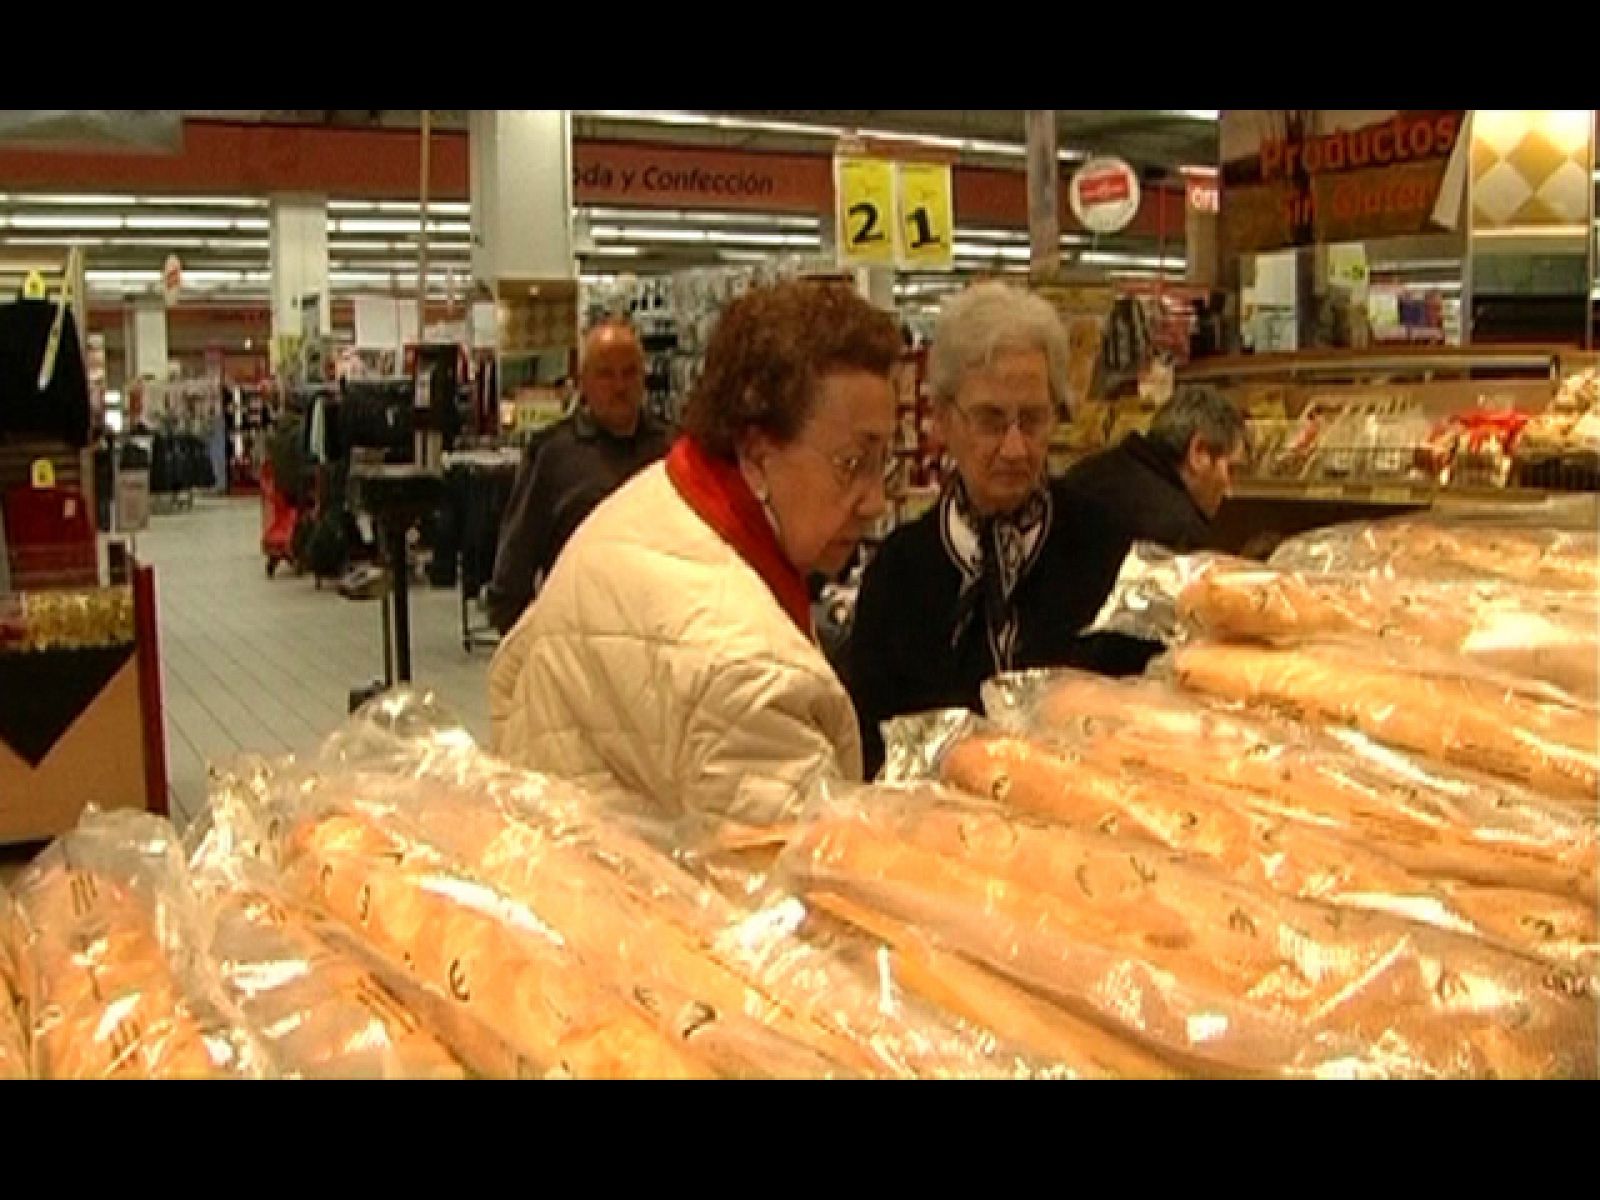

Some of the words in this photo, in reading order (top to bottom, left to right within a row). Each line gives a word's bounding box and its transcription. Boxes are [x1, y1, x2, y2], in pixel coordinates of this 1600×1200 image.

[621, 168, 634, 193] y
[643, 165, 773, 196] Confección
[849, 202, 884, 244] 2
[906, 207, 940, 248] 1
